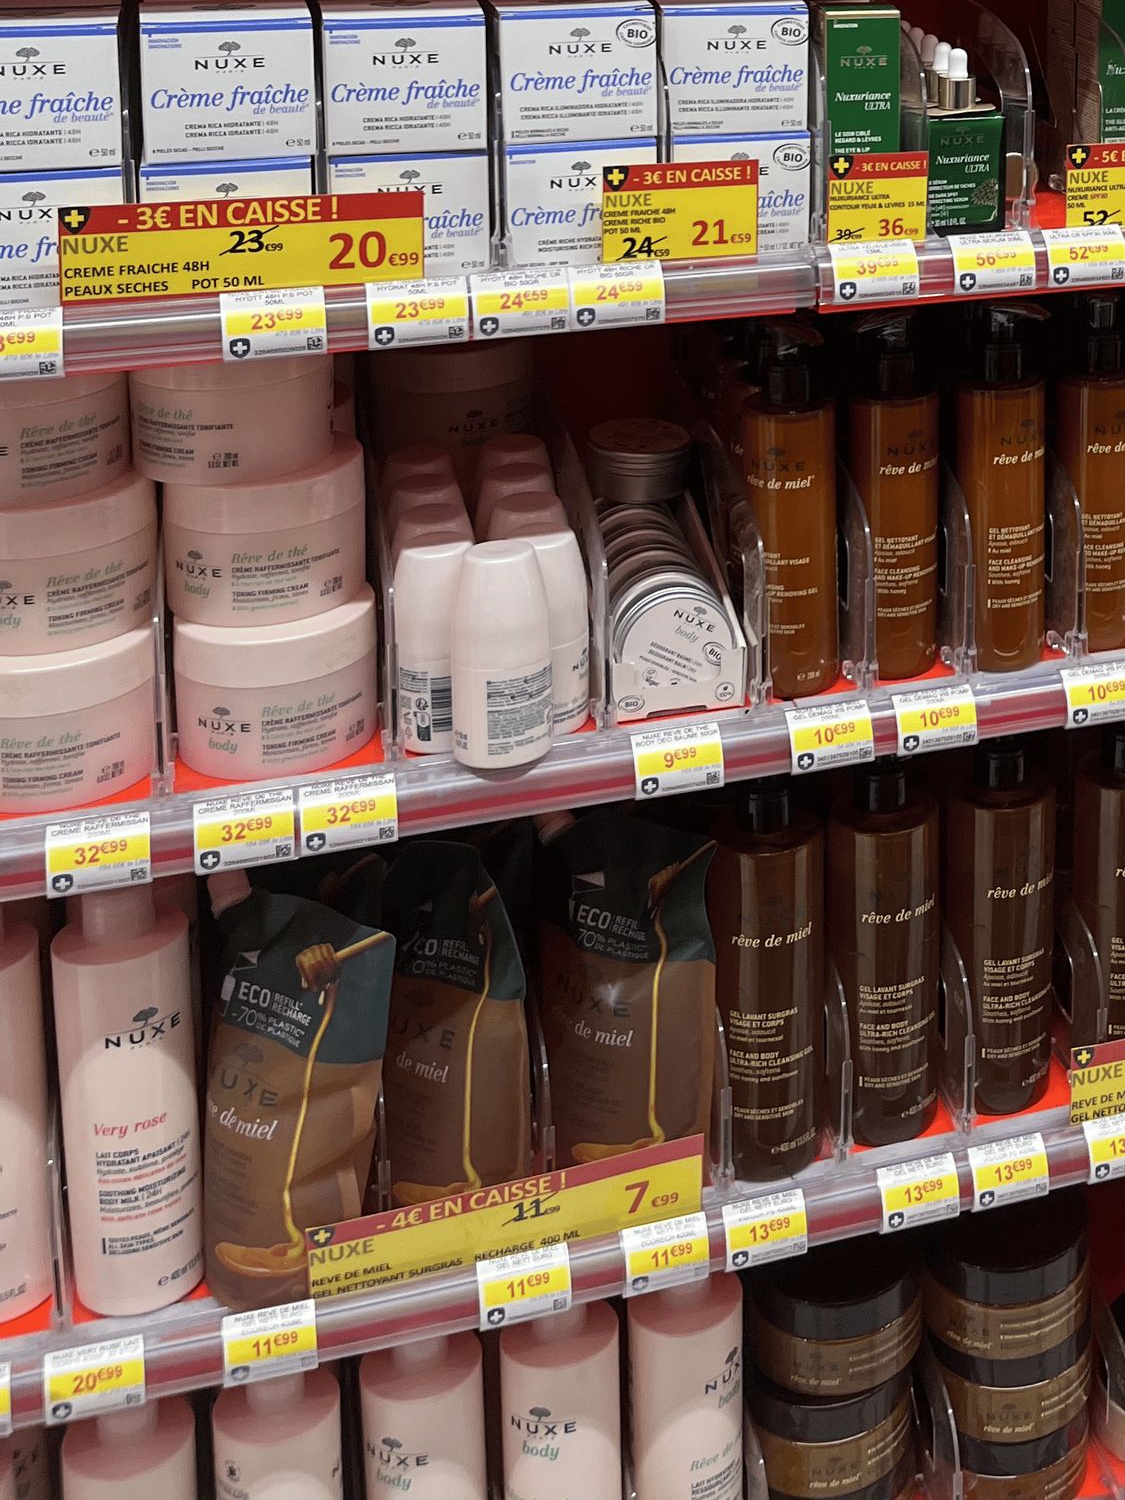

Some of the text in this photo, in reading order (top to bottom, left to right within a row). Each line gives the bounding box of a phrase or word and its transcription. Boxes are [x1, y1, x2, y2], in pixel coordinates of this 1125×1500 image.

[627, 29, 648, 39] BIO
[549, 43, 611, 54] NUXE
[195, 57, 265, 71] NUXE
[643, 167, 741, 185] 3€ EN CAISSE
[1069, 171, 1108, 184] NUXE
[136, 199, 321, 229] 3€ EN CAISSE
[63, 236, 129, 255] NUXE
[329, 232, 419, 270] 20€99
[65, 260, 209, 279] CREME FRAICHE 48H
[65, 276, 264, 297] PEAUX SECHES POT 50 ML
[500, 290, 548, 310] 24€59
[231, 545, 308, 565] Rêve de thé
[1088, 681, 1125, 700] 10€99
[198, 719, 251, 733] NUXE
[208, 737, 238, 753] body
[664, 747, 697, 768] 9€99
[73, 840, 127, 864] 32€99
[731, 923, 812, 949] rêve de miel
[238, 981, 271, 1007] ECO
[103, 1010, 182, 1050] NUXE
[1071, 1097, 1098, 1111] REVE
[1099, 1093, 1114, 1107] DE
[92, 1111, 168, 1139] Very rose
[995, 1159, 1032, 1181] 13€99
[309, 1239, 374, 1265] NUXE
[72, 1365, 123, 1392] 20€99
[512, 1417, 576, 1436] NUXE
[523, 1440, 560, 1459] body
